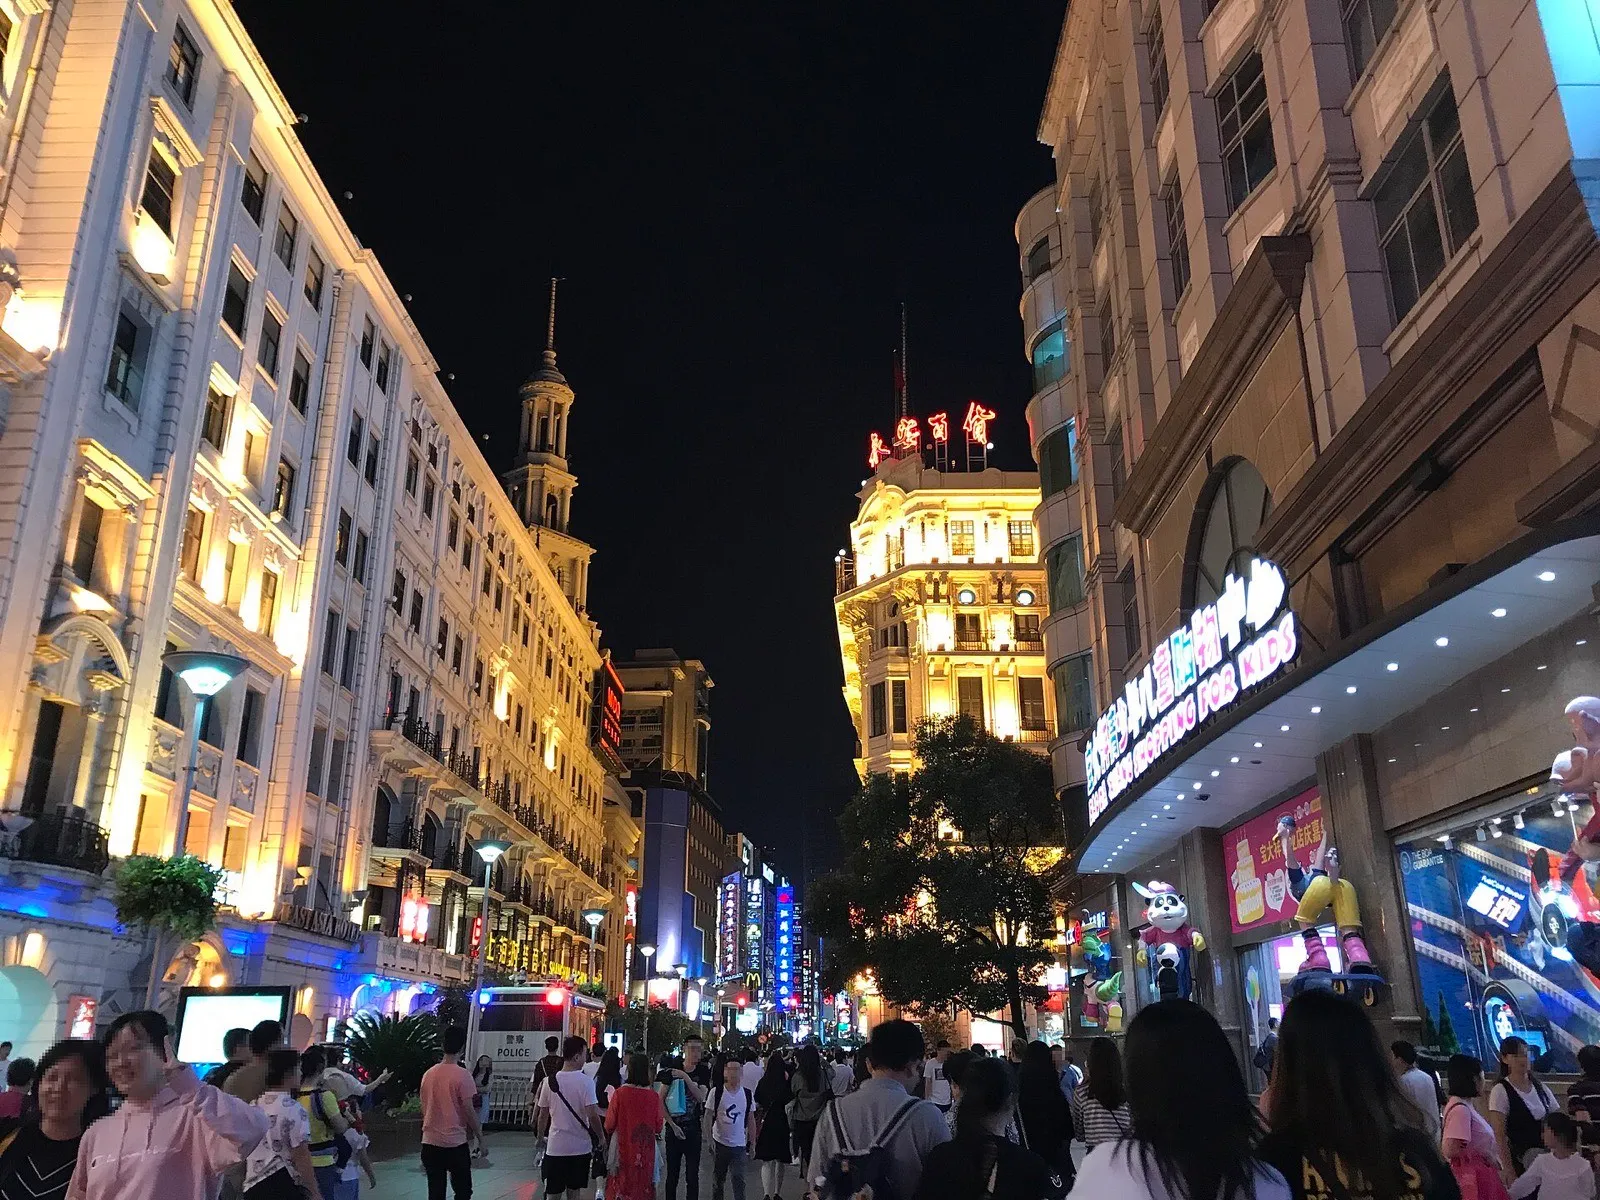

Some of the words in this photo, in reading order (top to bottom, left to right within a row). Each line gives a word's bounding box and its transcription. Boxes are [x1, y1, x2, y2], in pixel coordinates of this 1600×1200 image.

[1197, 662, 1239, 724] FOR
[1238, 611, 1297, 690] KIDS
[281, 901, 312, 930] EAST
[311, 910, 334, 936] ASIA
[506, 1034, 525, 1045] 警察
[497, 1048, 530, 1057] POLICE
